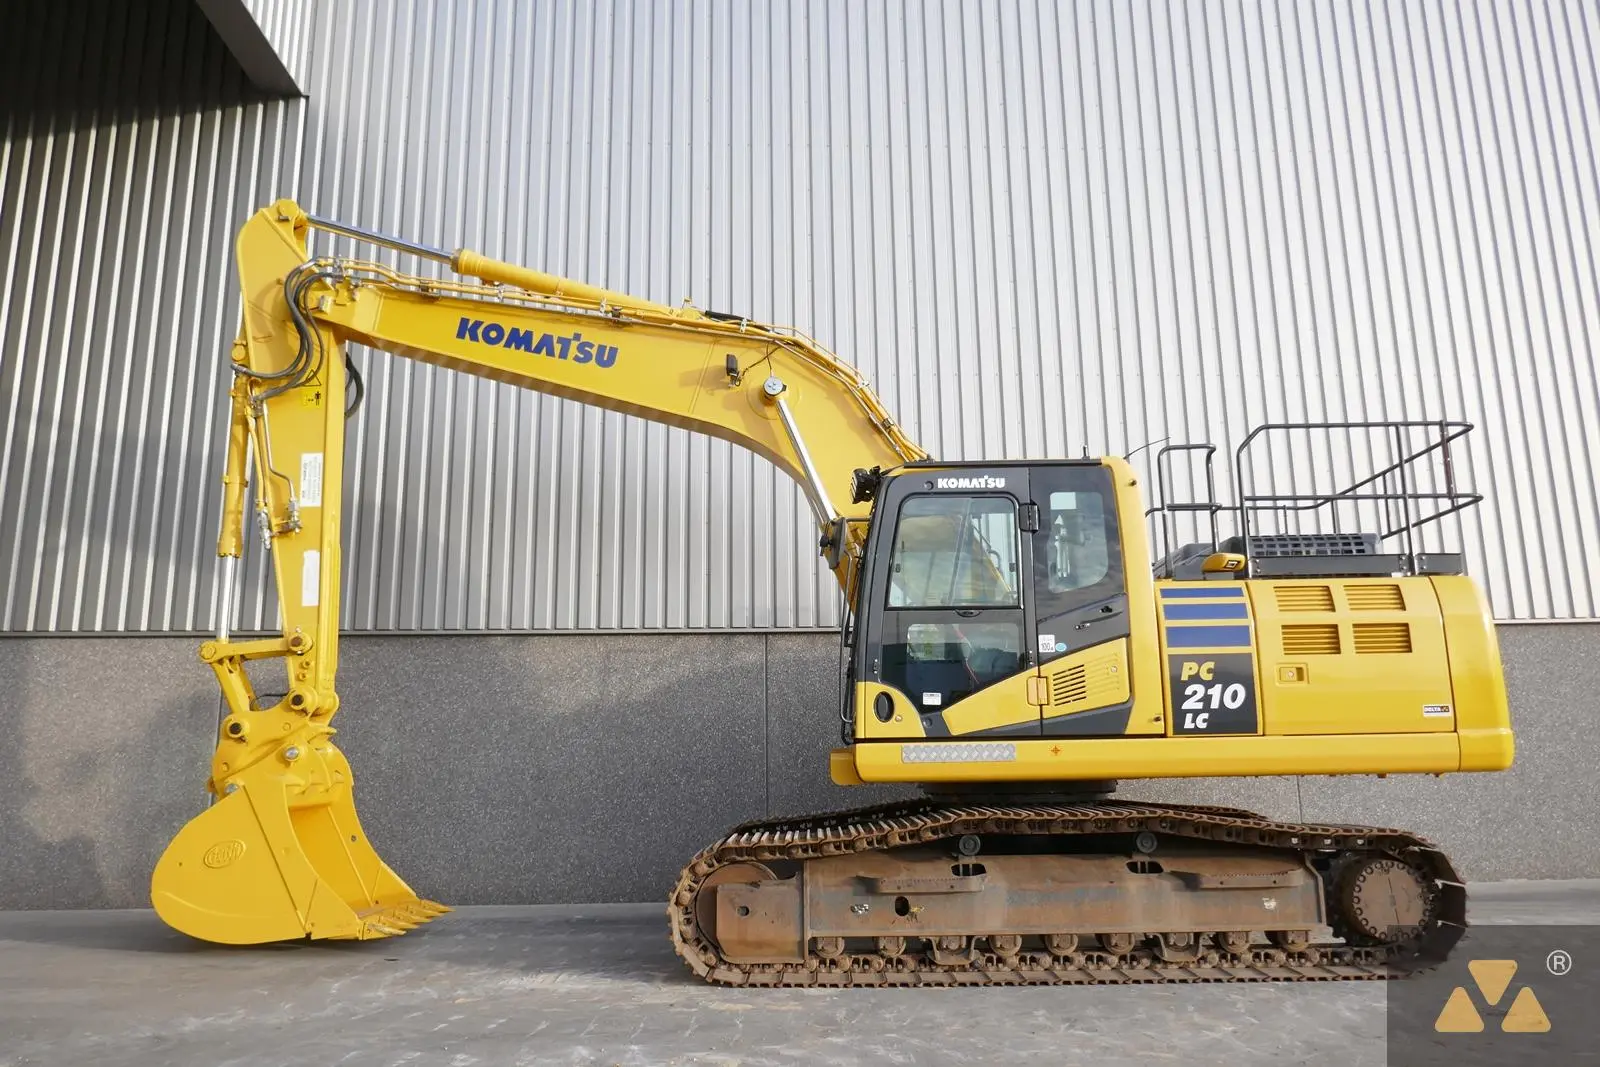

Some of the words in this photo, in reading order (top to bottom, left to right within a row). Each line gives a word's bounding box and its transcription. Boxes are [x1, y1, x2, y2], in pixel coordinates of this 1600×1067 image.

[456, 317, 619, 368] KOMATSU
[938, 475, 1005, 488] KOMATSU
[1181, 661, 1215, 680] PC
[1181, 683, 1246, 709] 210
[1184, 713, 1209, 728] LC
